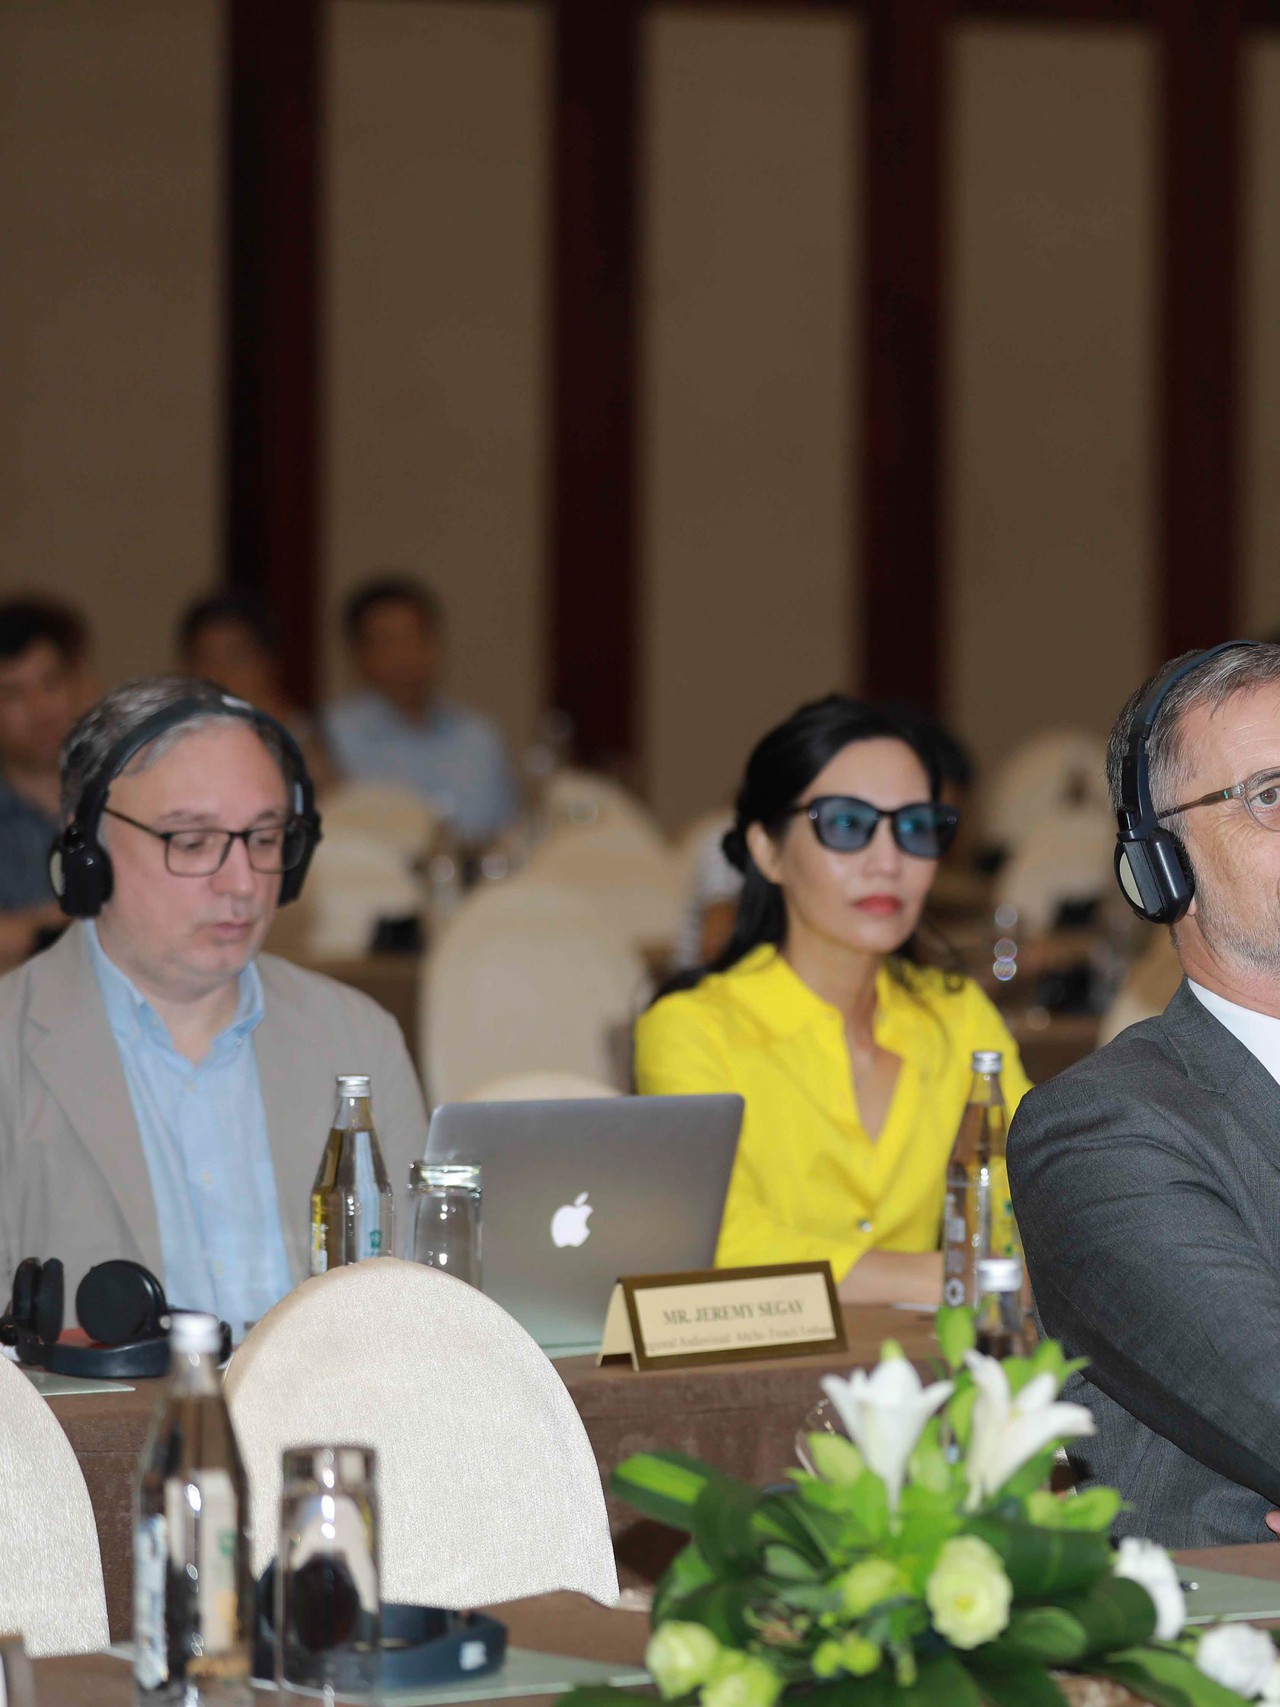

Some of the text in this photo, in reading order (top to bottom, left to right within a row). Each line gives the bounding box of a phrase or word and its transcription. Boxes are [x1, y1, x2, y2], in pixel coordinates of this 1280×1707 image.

[662, 1300, 804, 1327] MR. JEREMY SEGAY
